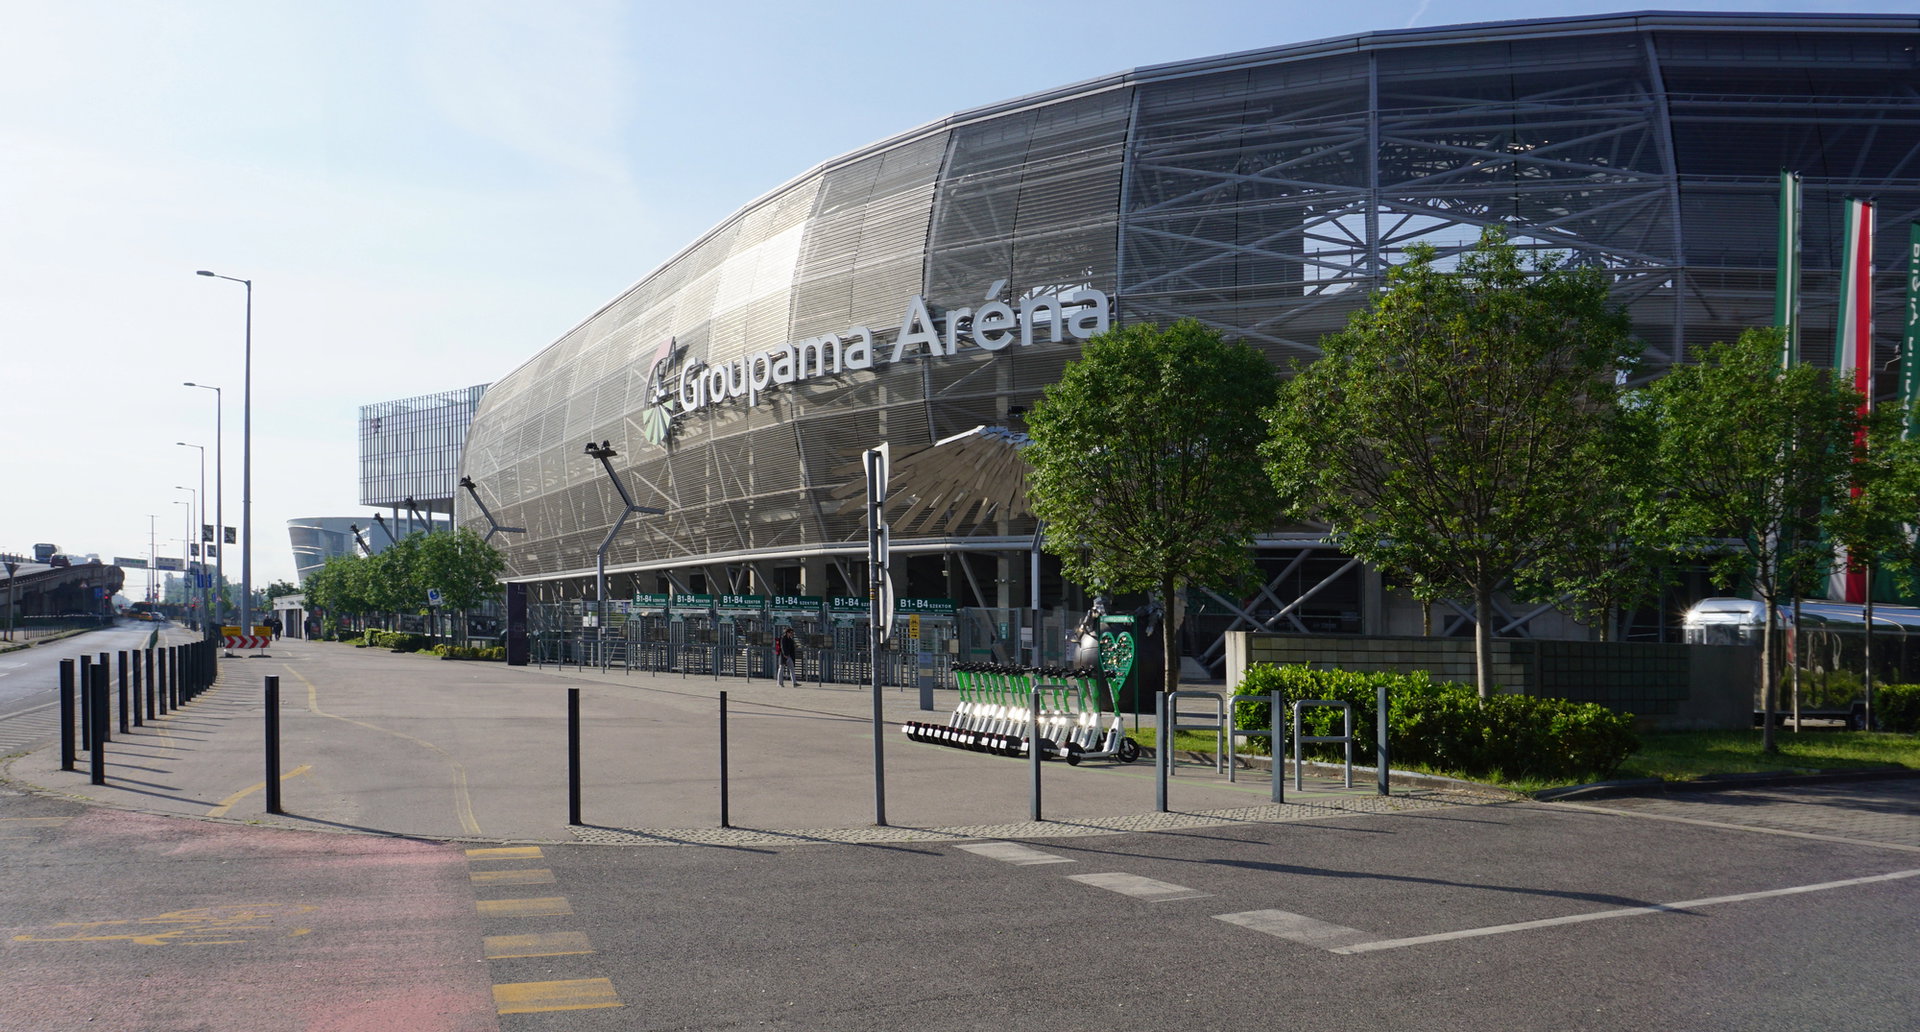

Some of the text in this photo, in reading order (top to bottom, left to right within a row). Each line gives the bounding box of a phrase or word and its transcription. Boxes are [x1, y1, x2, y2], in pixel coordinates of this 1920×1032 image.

[679, 279, 1110, 412] Groupama Aréna
[676, 594, 695, 603] B1-B4
[722, 595, 743, 604] B1-B4
[775, 596, 798, 605] B1-B4
[834, 597, 859, 607] B1-B4
[900, 599, 929, 608] B1-B4
